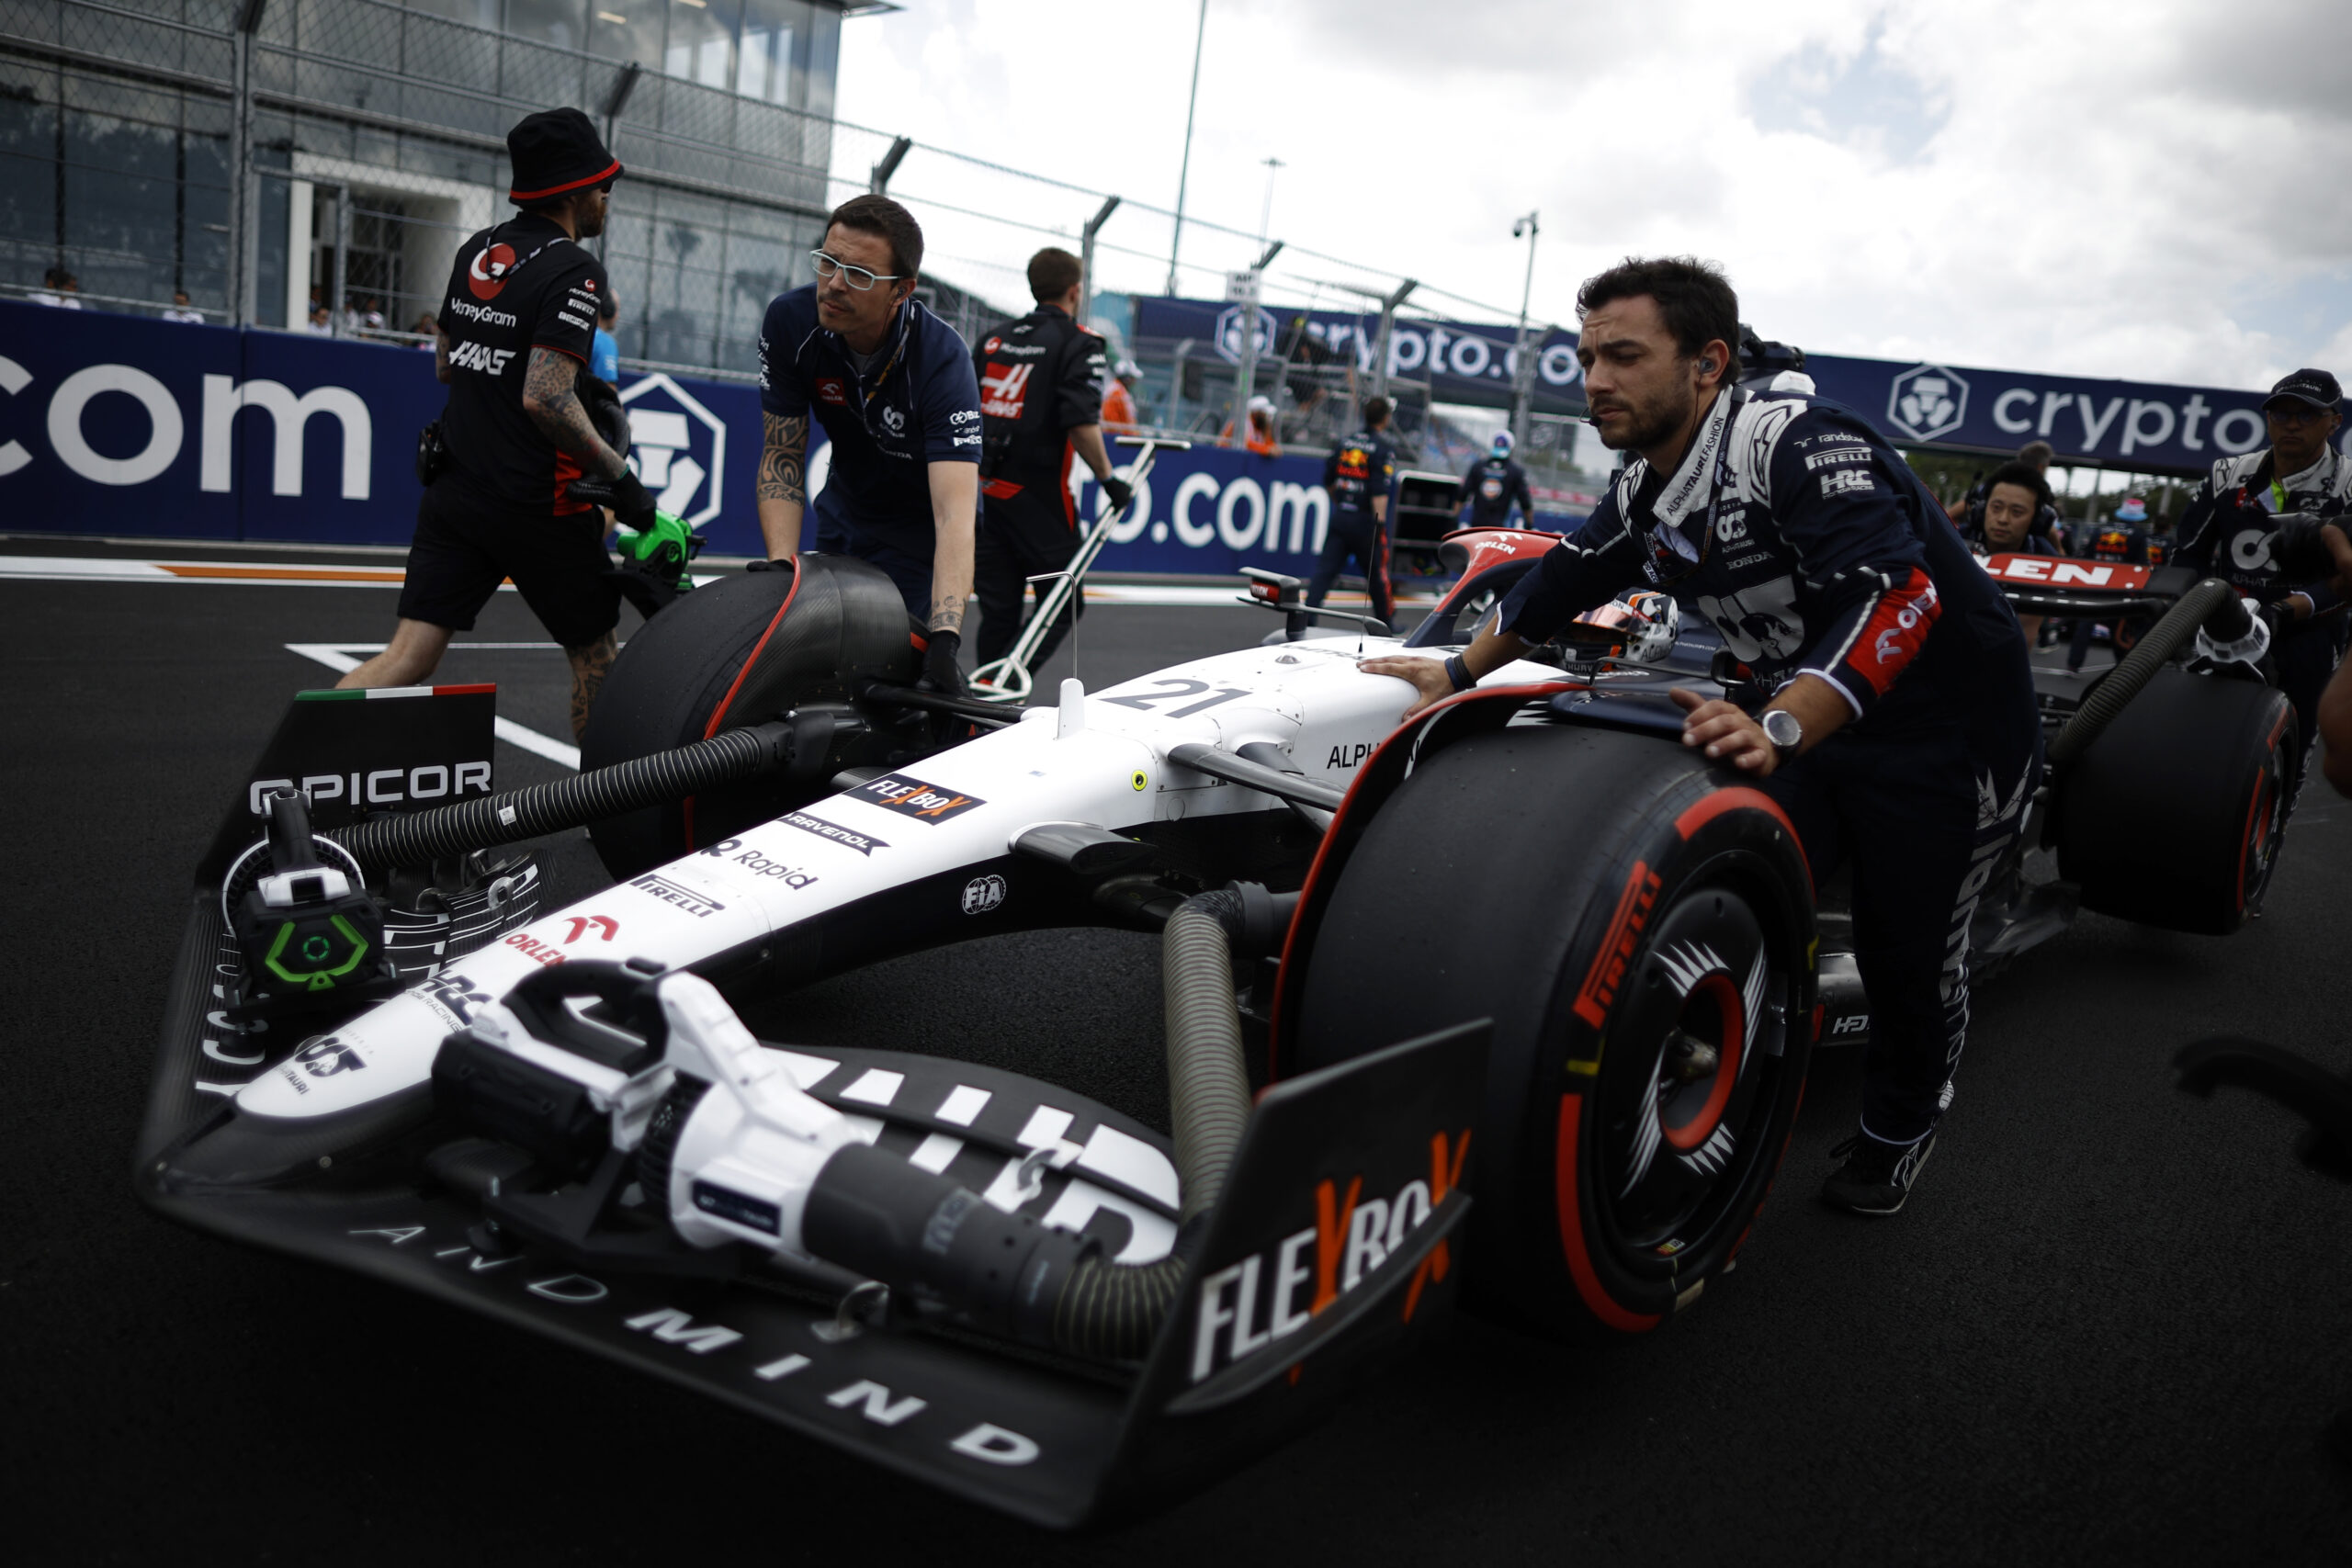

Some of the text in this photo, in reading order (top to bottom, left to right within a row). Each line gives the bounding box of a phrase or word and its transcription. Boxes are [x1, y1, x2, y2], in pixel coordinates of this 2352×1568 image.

[451, 297, 516, 328] MoneyGram
[448, 340, 516, 376] HAAS
[0, 355, 372, 501] om
[1805, 447, 1872, 470] PIRELLI
[1820, 469, 1873, 494] HRC
[1973, 554, 2114, 586] LEN
[1097, 679, 1254, 719] 21
[866, 780, 972, 816] FLEXBOX
[788, 814, 872, 850] RAVENOL
[732, 850, 819, 890] Rapid
[629, 874, 726, 918] PIRELLI
[1573, 860, 1663, 1030] PIRELLI
[623, 1306, 1040, 1465] MIND
